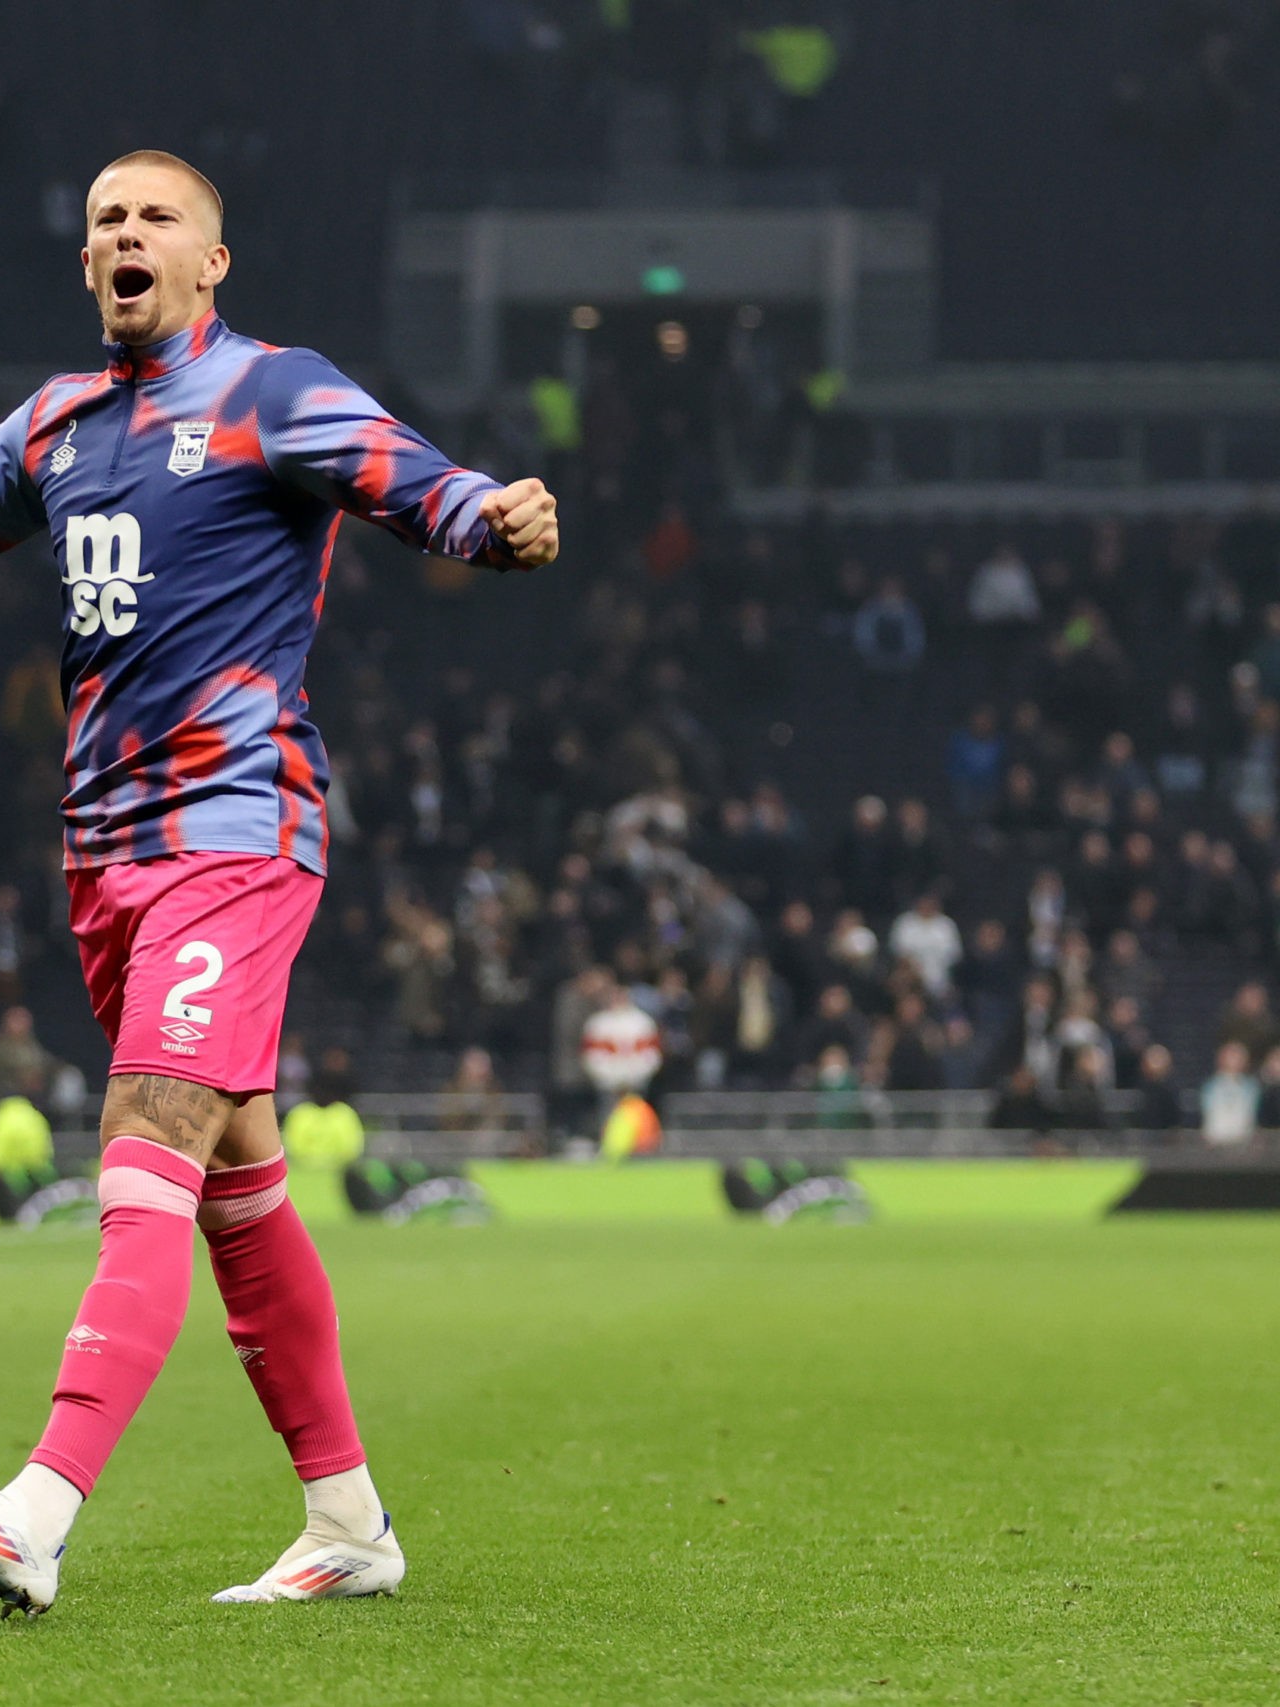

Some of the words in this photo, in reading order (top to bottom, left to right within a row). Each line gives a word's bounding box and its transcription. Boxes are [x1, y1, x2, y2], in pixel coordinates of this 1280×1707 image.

[62, 512, 154, 584] m
[71, 580, 138, 636] sc
[162, 940, 223, 1025] 2
[161, 1041, 196, 1055] umbro
[322, 1555, 372, 1571] F50
